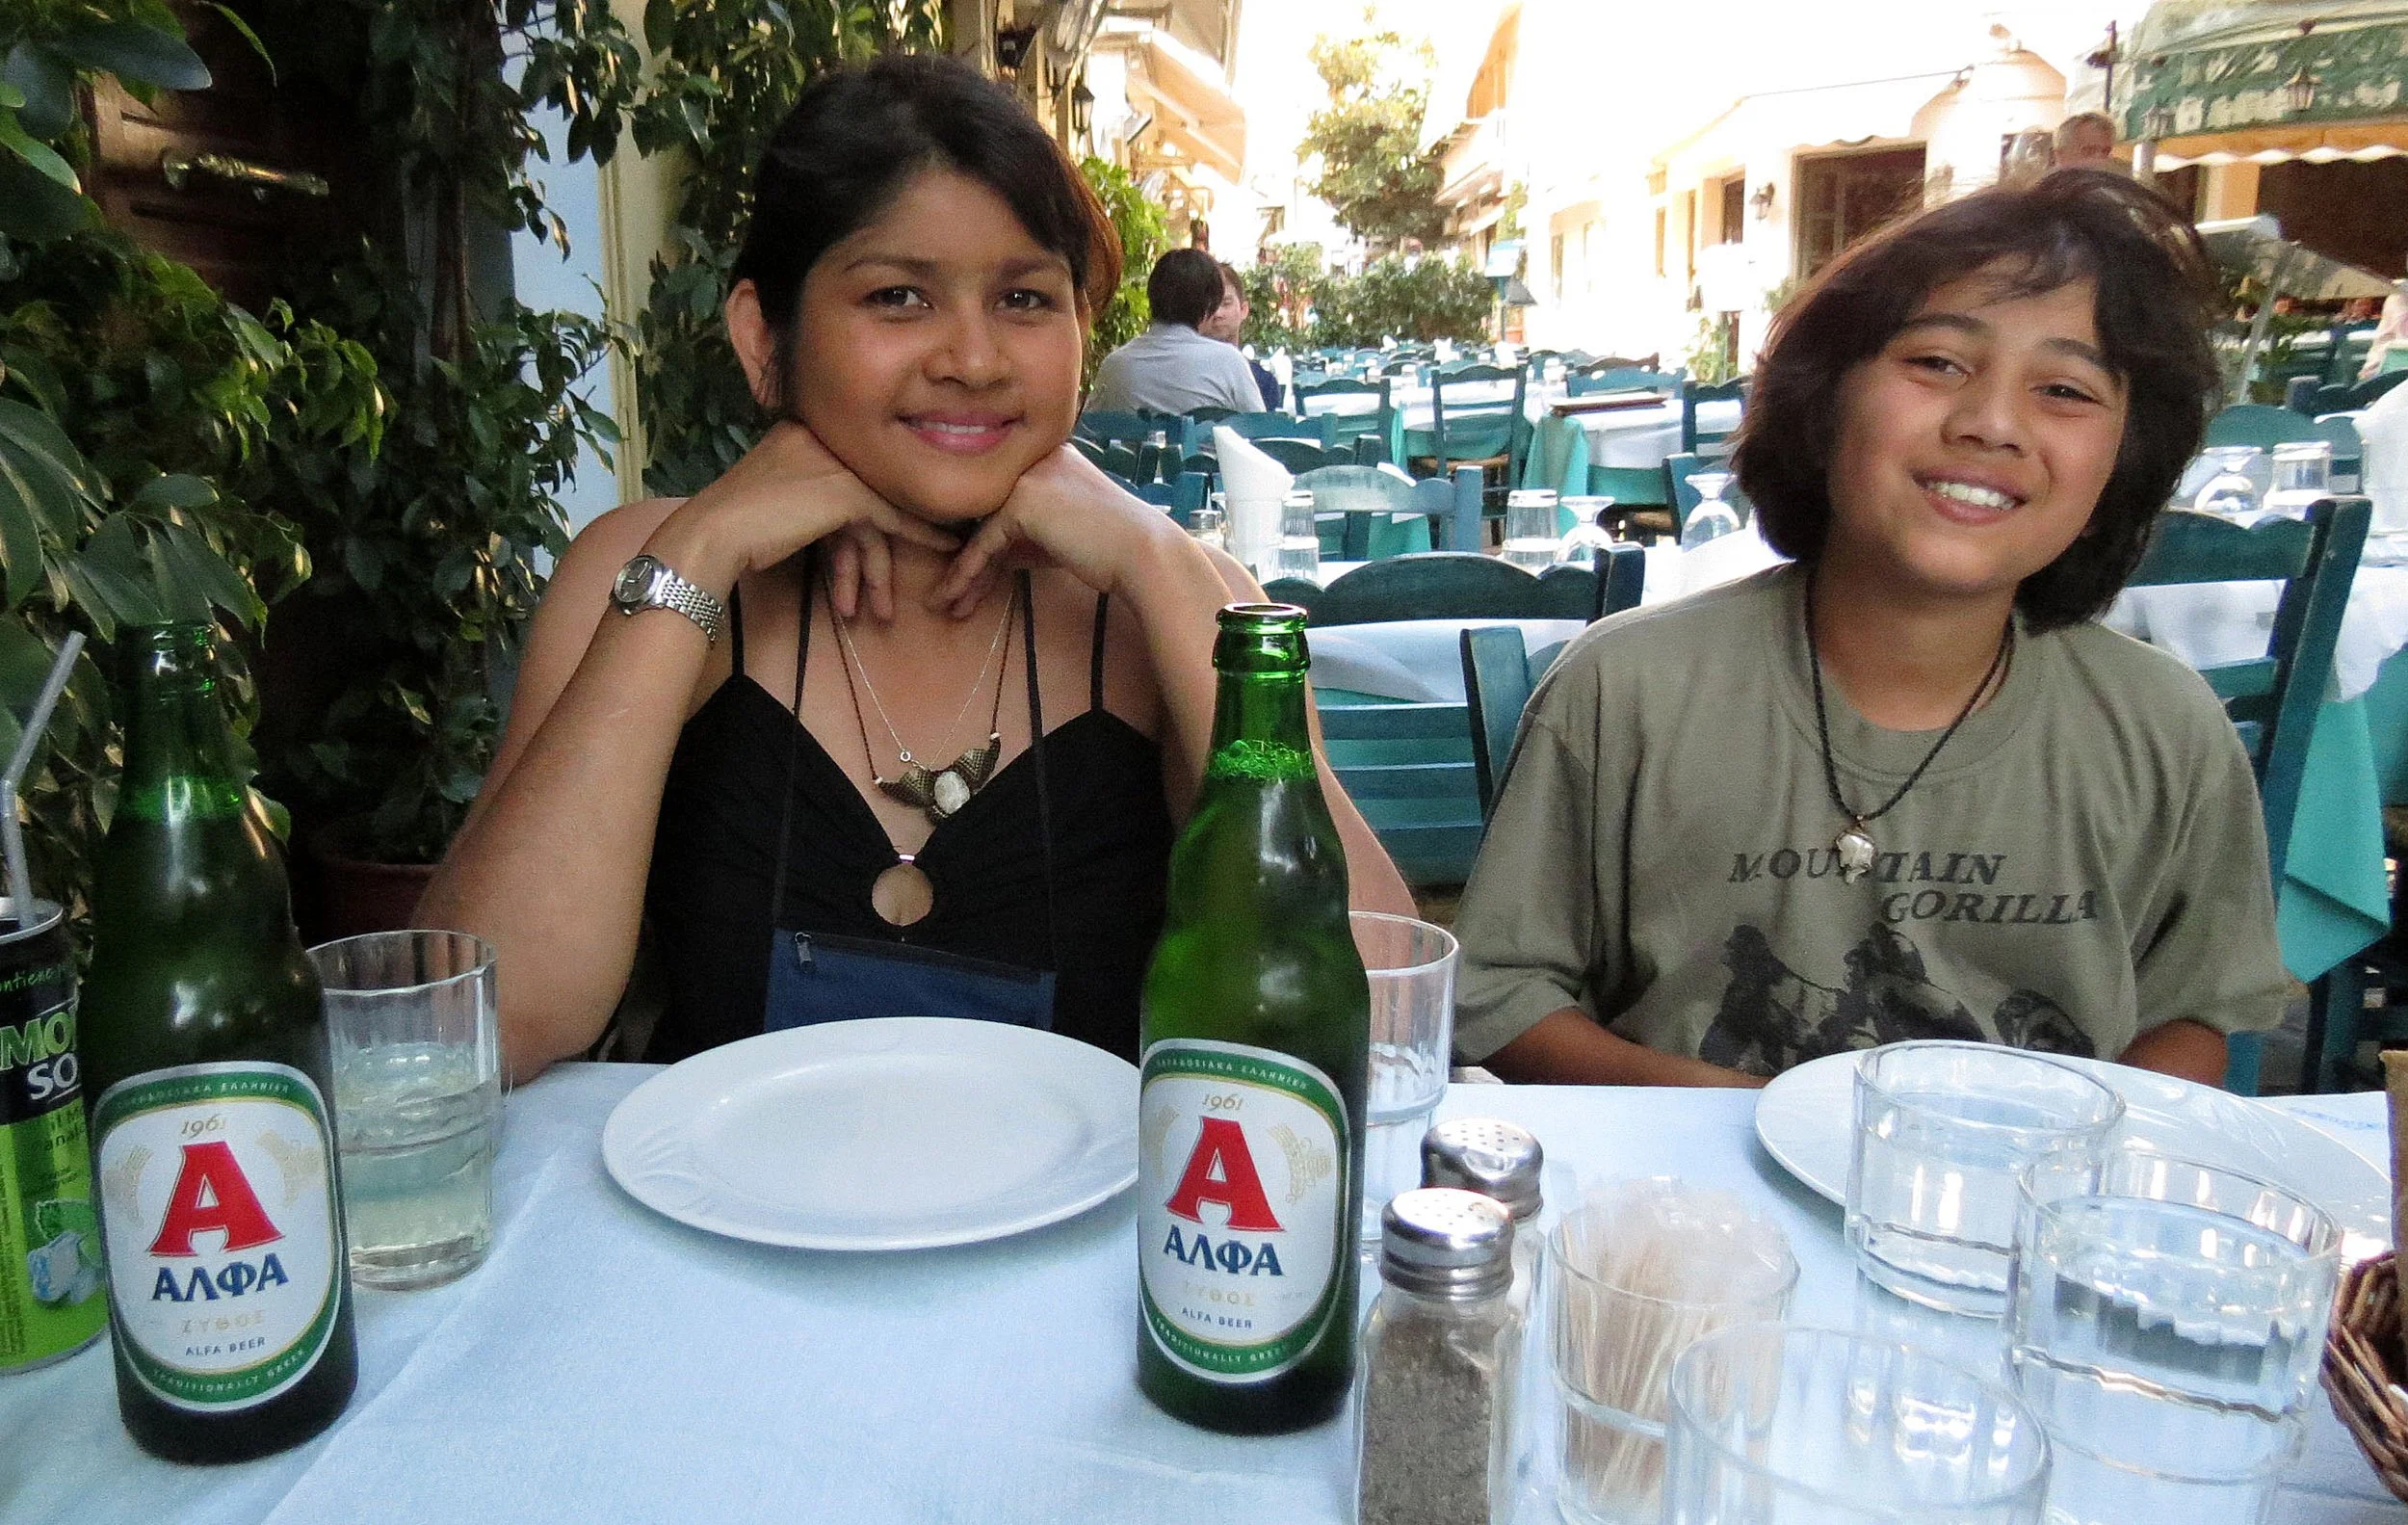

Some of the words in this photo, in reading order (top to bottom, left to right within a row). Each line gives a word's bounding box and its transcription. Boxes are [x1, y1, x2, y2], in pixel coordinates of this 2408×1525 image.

[1727, 847, 2007, 884] MOUTAIN
[1879, 888, 2098, 924] GORILLA
[0, 967, 52, 992] ntiene
[0, 1008, 76, 1070] MO
[1203, 1093, 1243, 1111] 1961
[181, 1114, 227, 1139] 1961
[1181, 1307, 1213, 1324] ALFA
[1218, 1317, 1252, 1329] BEER
[186, 1346, 222, 1356] ALFA
[229, 1336, 266, 1354] BEER
